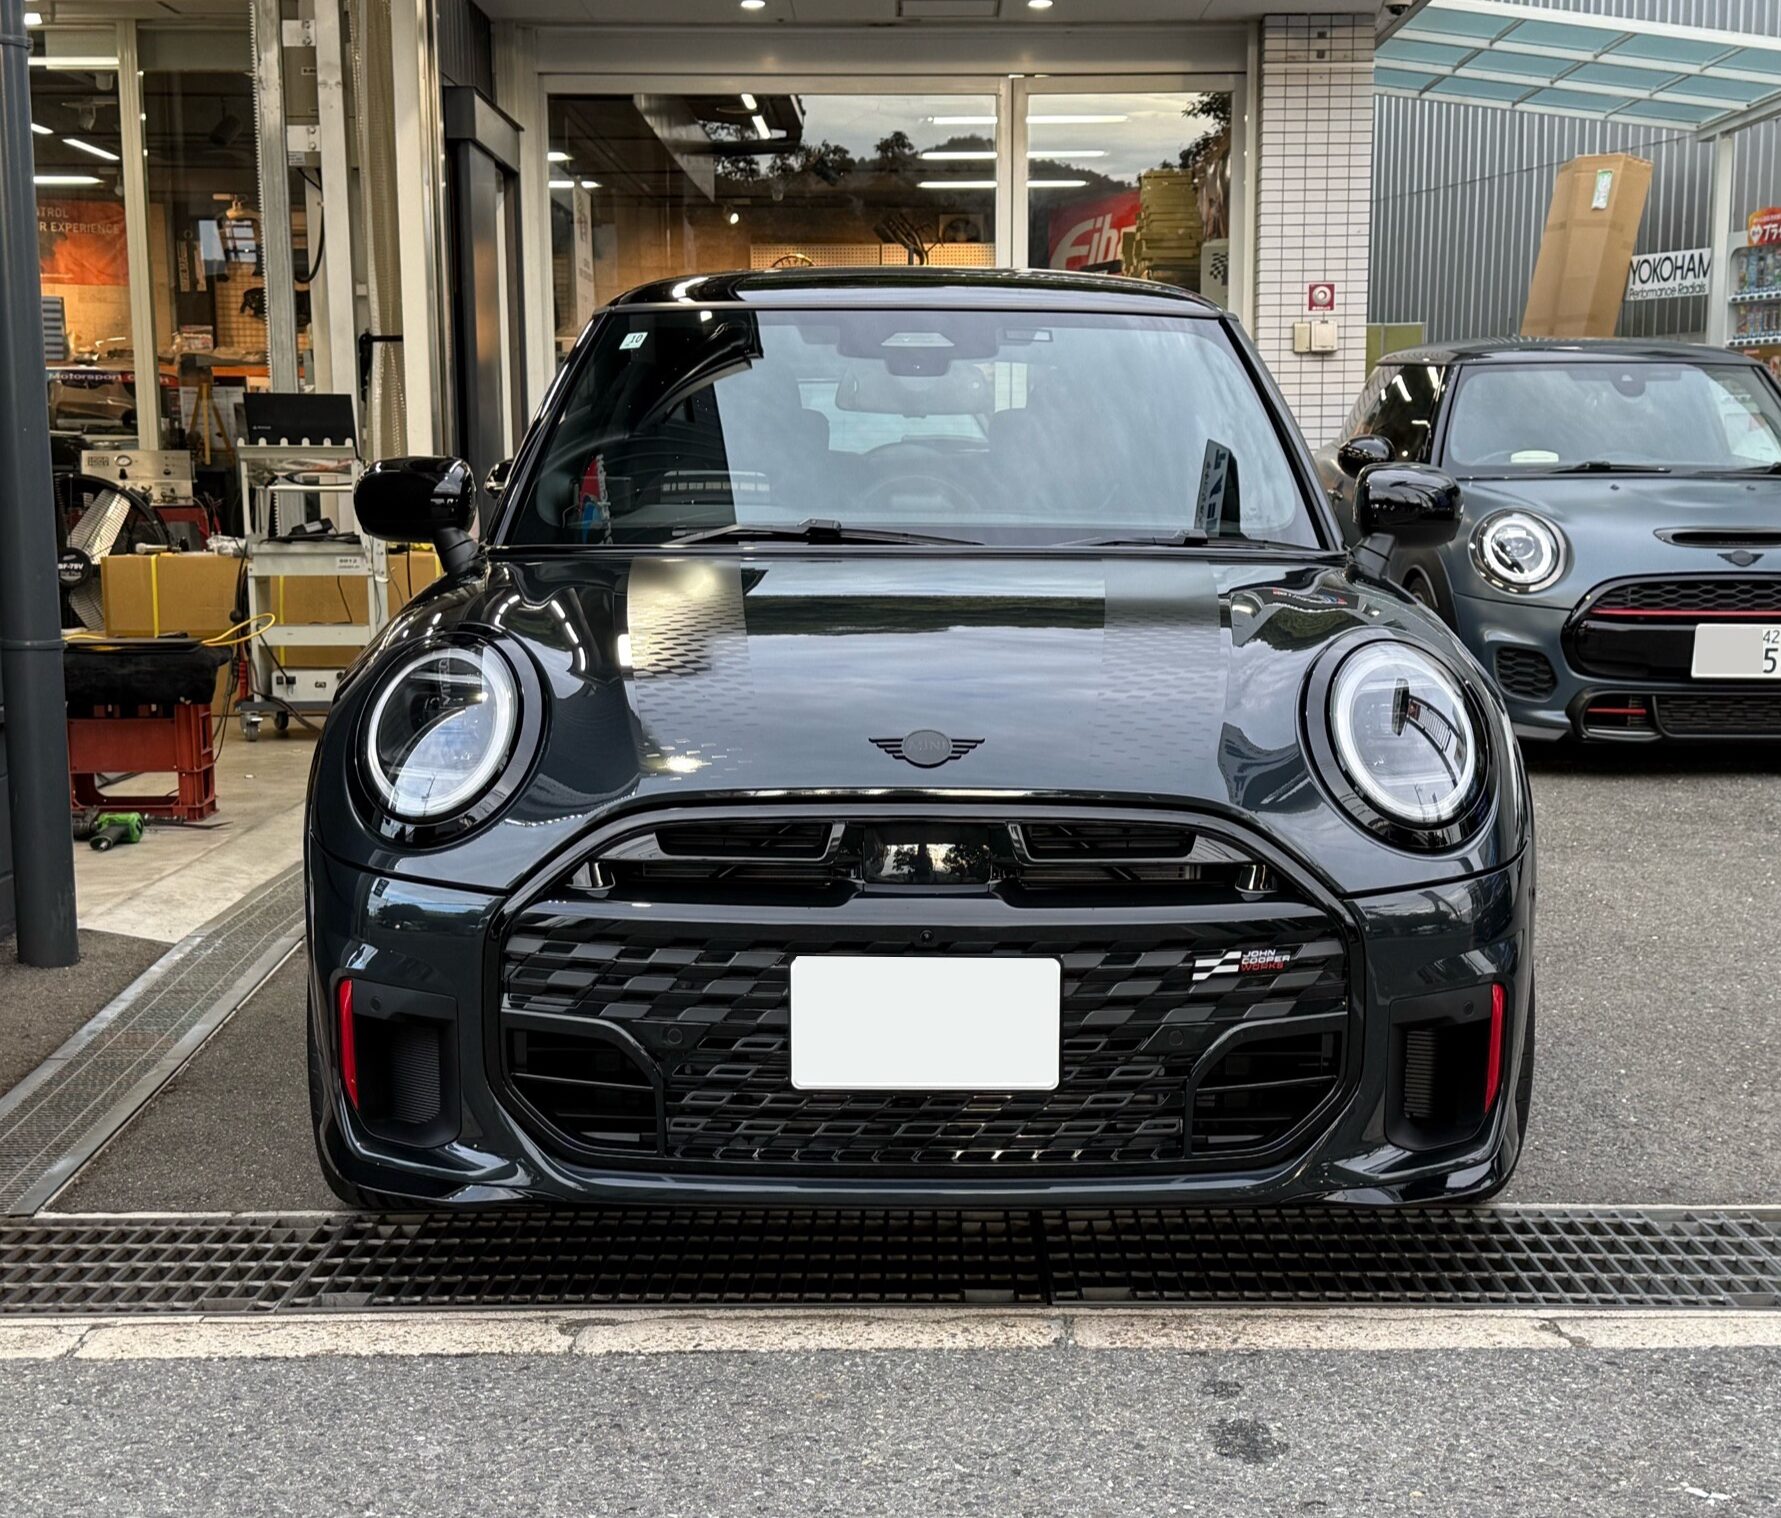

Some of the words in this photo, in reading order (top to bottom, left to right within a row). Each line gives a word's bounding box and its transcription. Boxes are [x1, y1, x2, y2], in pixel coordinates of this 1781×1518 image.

[50, 221, 119, 234] EXPERIENCE
[1630, 286, 1677, 299] Performance
[1678, 281, 1706, 294] Radials
[630, 334, 644, 344] 10
[1243, 949, 1276, 958] JOHN
[1241, 955, 1291, 965] COOPER
[1241, 962, 1285, 972] WORKS
